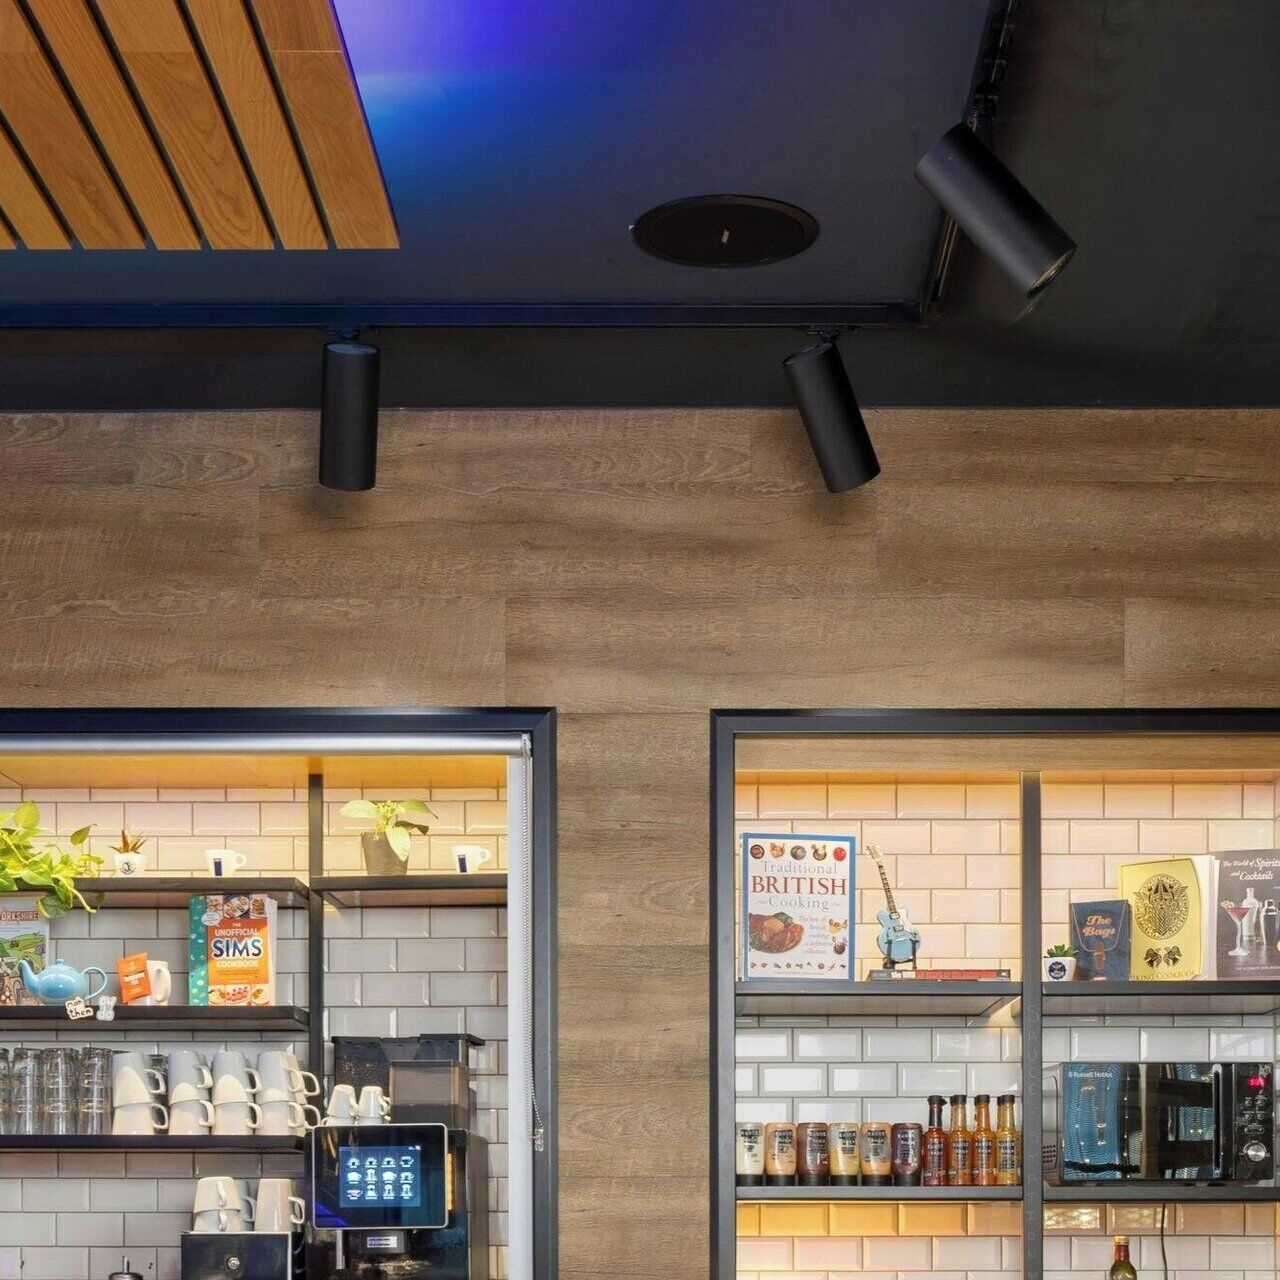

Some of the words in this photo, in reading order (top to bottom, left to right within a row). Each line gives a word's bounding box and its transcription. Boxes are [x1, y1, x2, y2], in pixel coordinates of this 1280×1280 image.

[761, 860, 837, 875] Traditional
[1239, 870, 1275, 880] Cocktails
[751, 875, 848, 896] BRITISH
[768, 896, 830, 912] Cooking
[1087, 915, 1112, 926] The
[215, 928, 259, 936] UNOFFICIAL
[212, 938, 262, 958] SIMS
[216, 959, 259, 967] COOKBOOK
[1129, 973, 1155, 981] IKING
